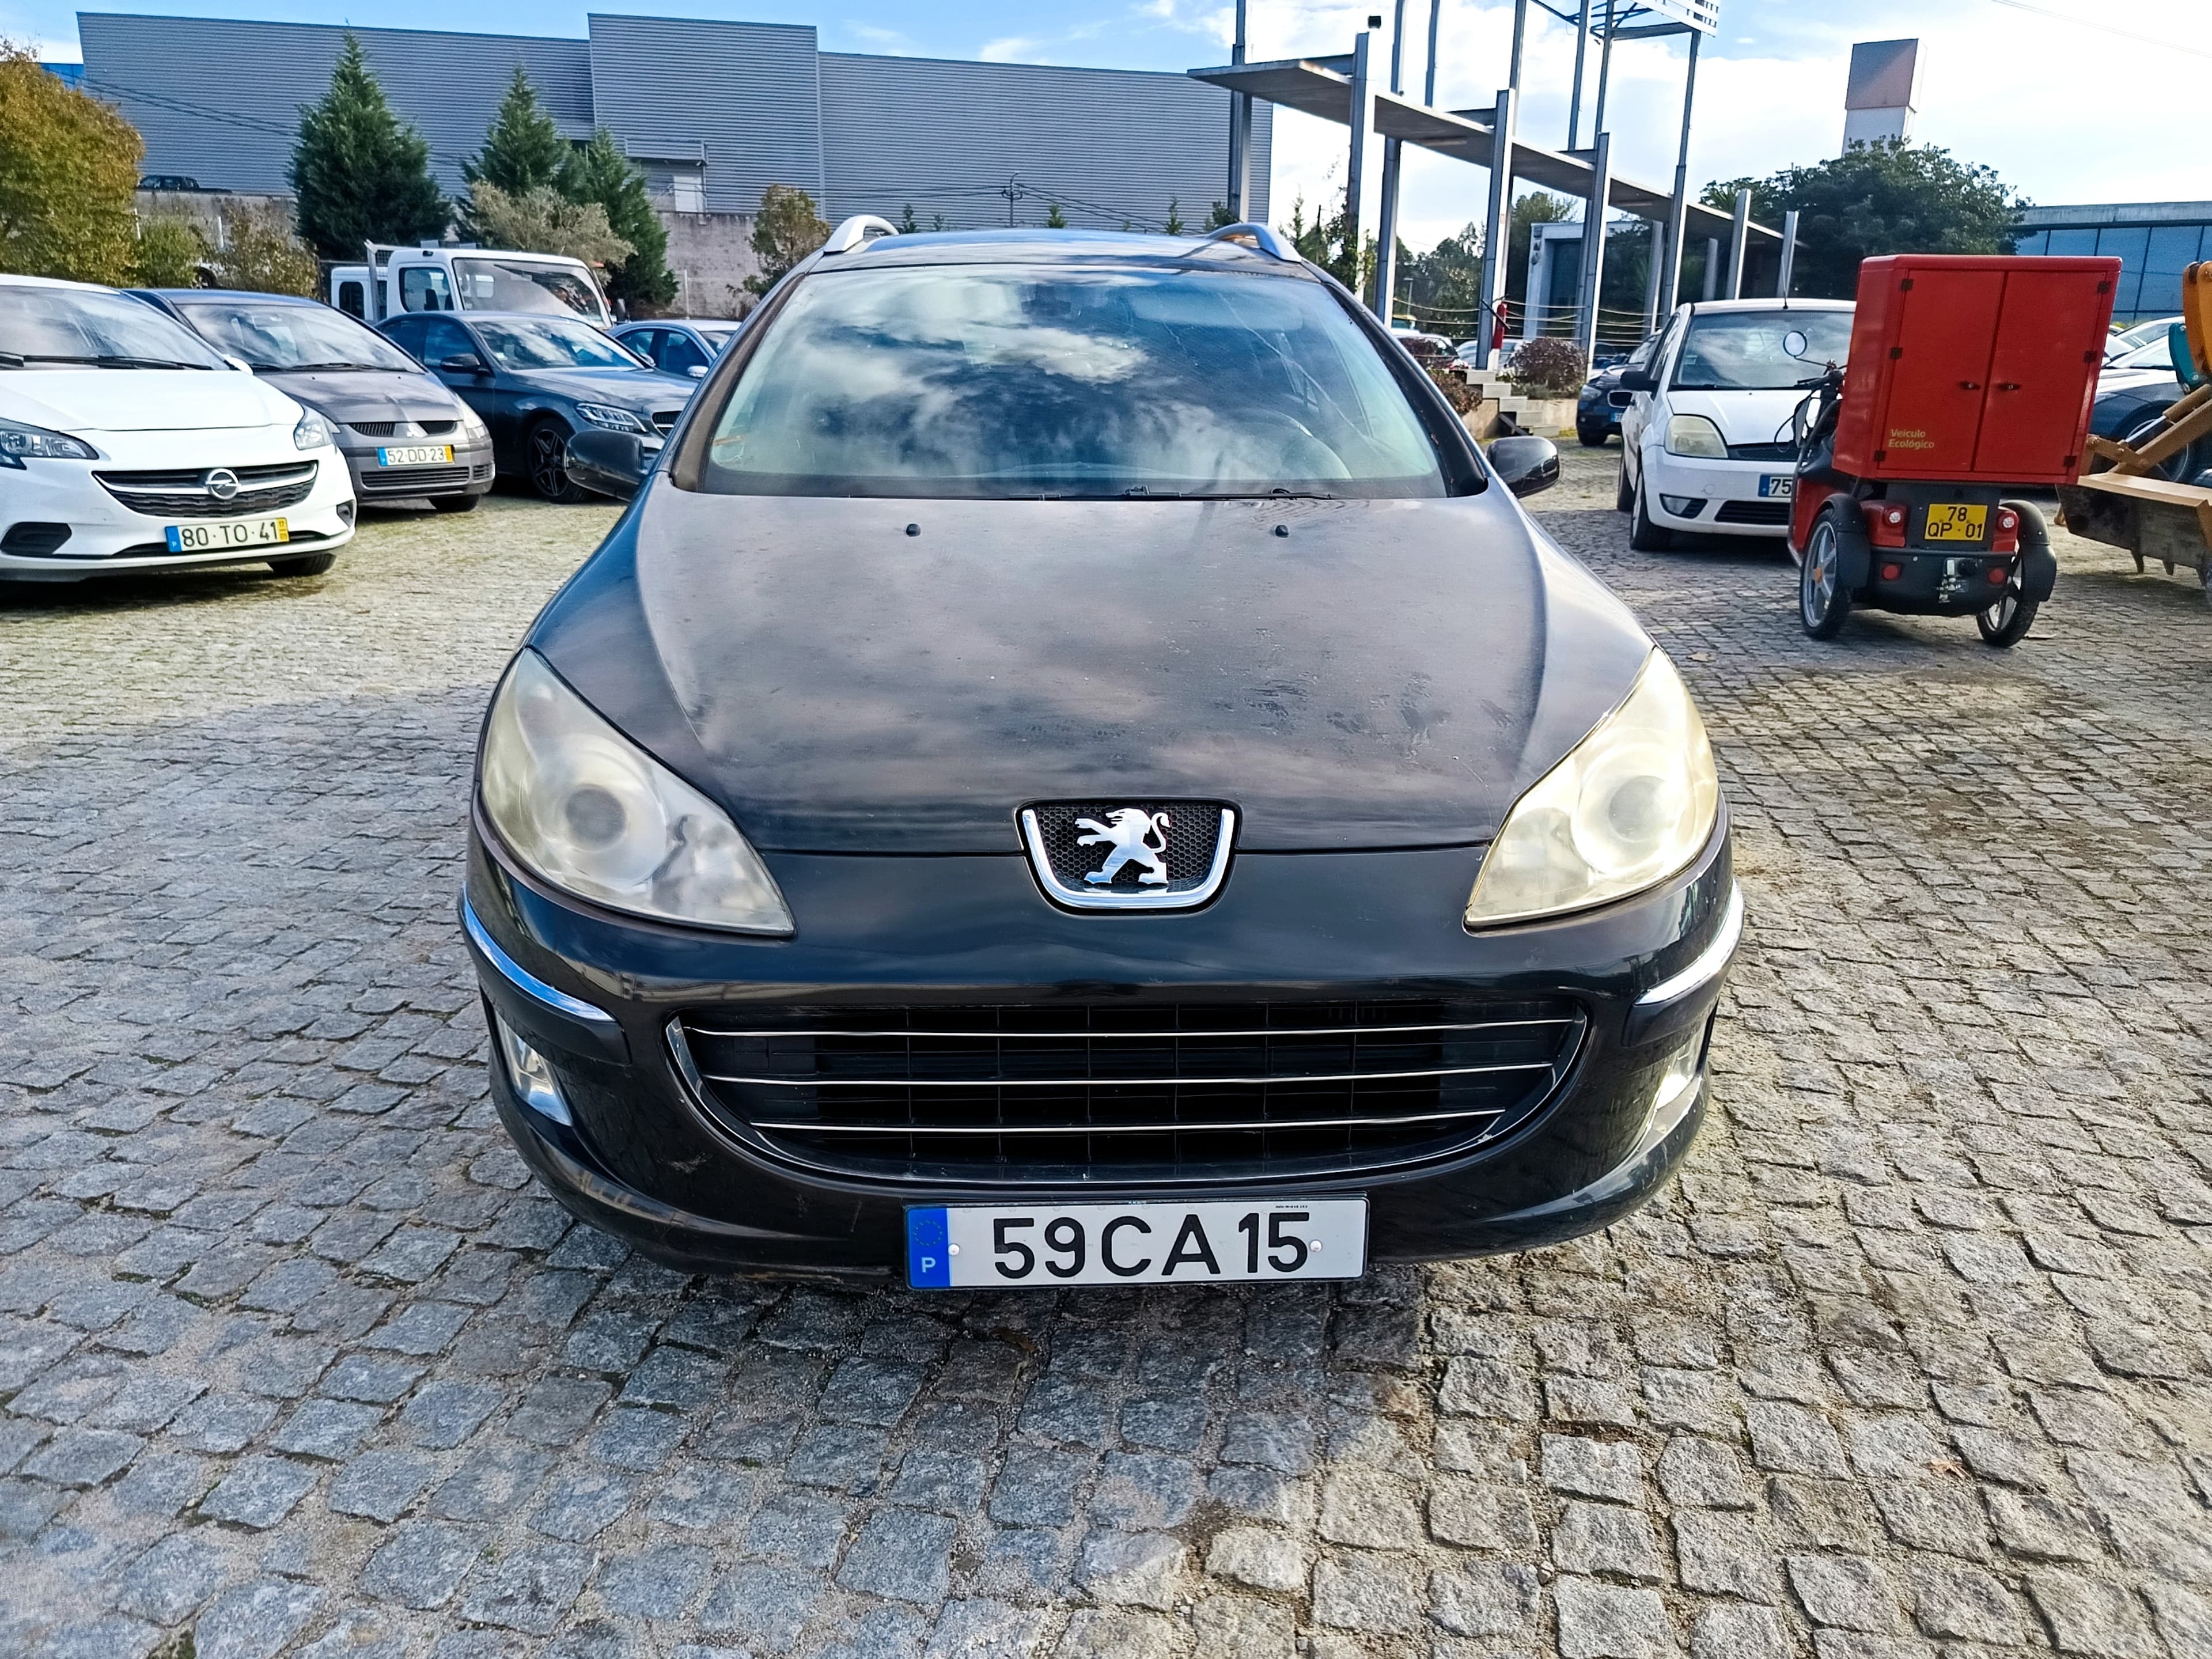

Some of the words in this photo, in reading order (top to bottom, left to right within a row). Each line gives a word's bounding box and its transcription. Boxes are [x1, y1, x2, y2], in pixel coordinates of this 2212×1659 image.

[1889, 438, 1935, 450] Ecológico
[1771, 479, 1793, 494] 75
[1948, 506, 1968, 522] 78
[921, 1257, 936, 1273] P
